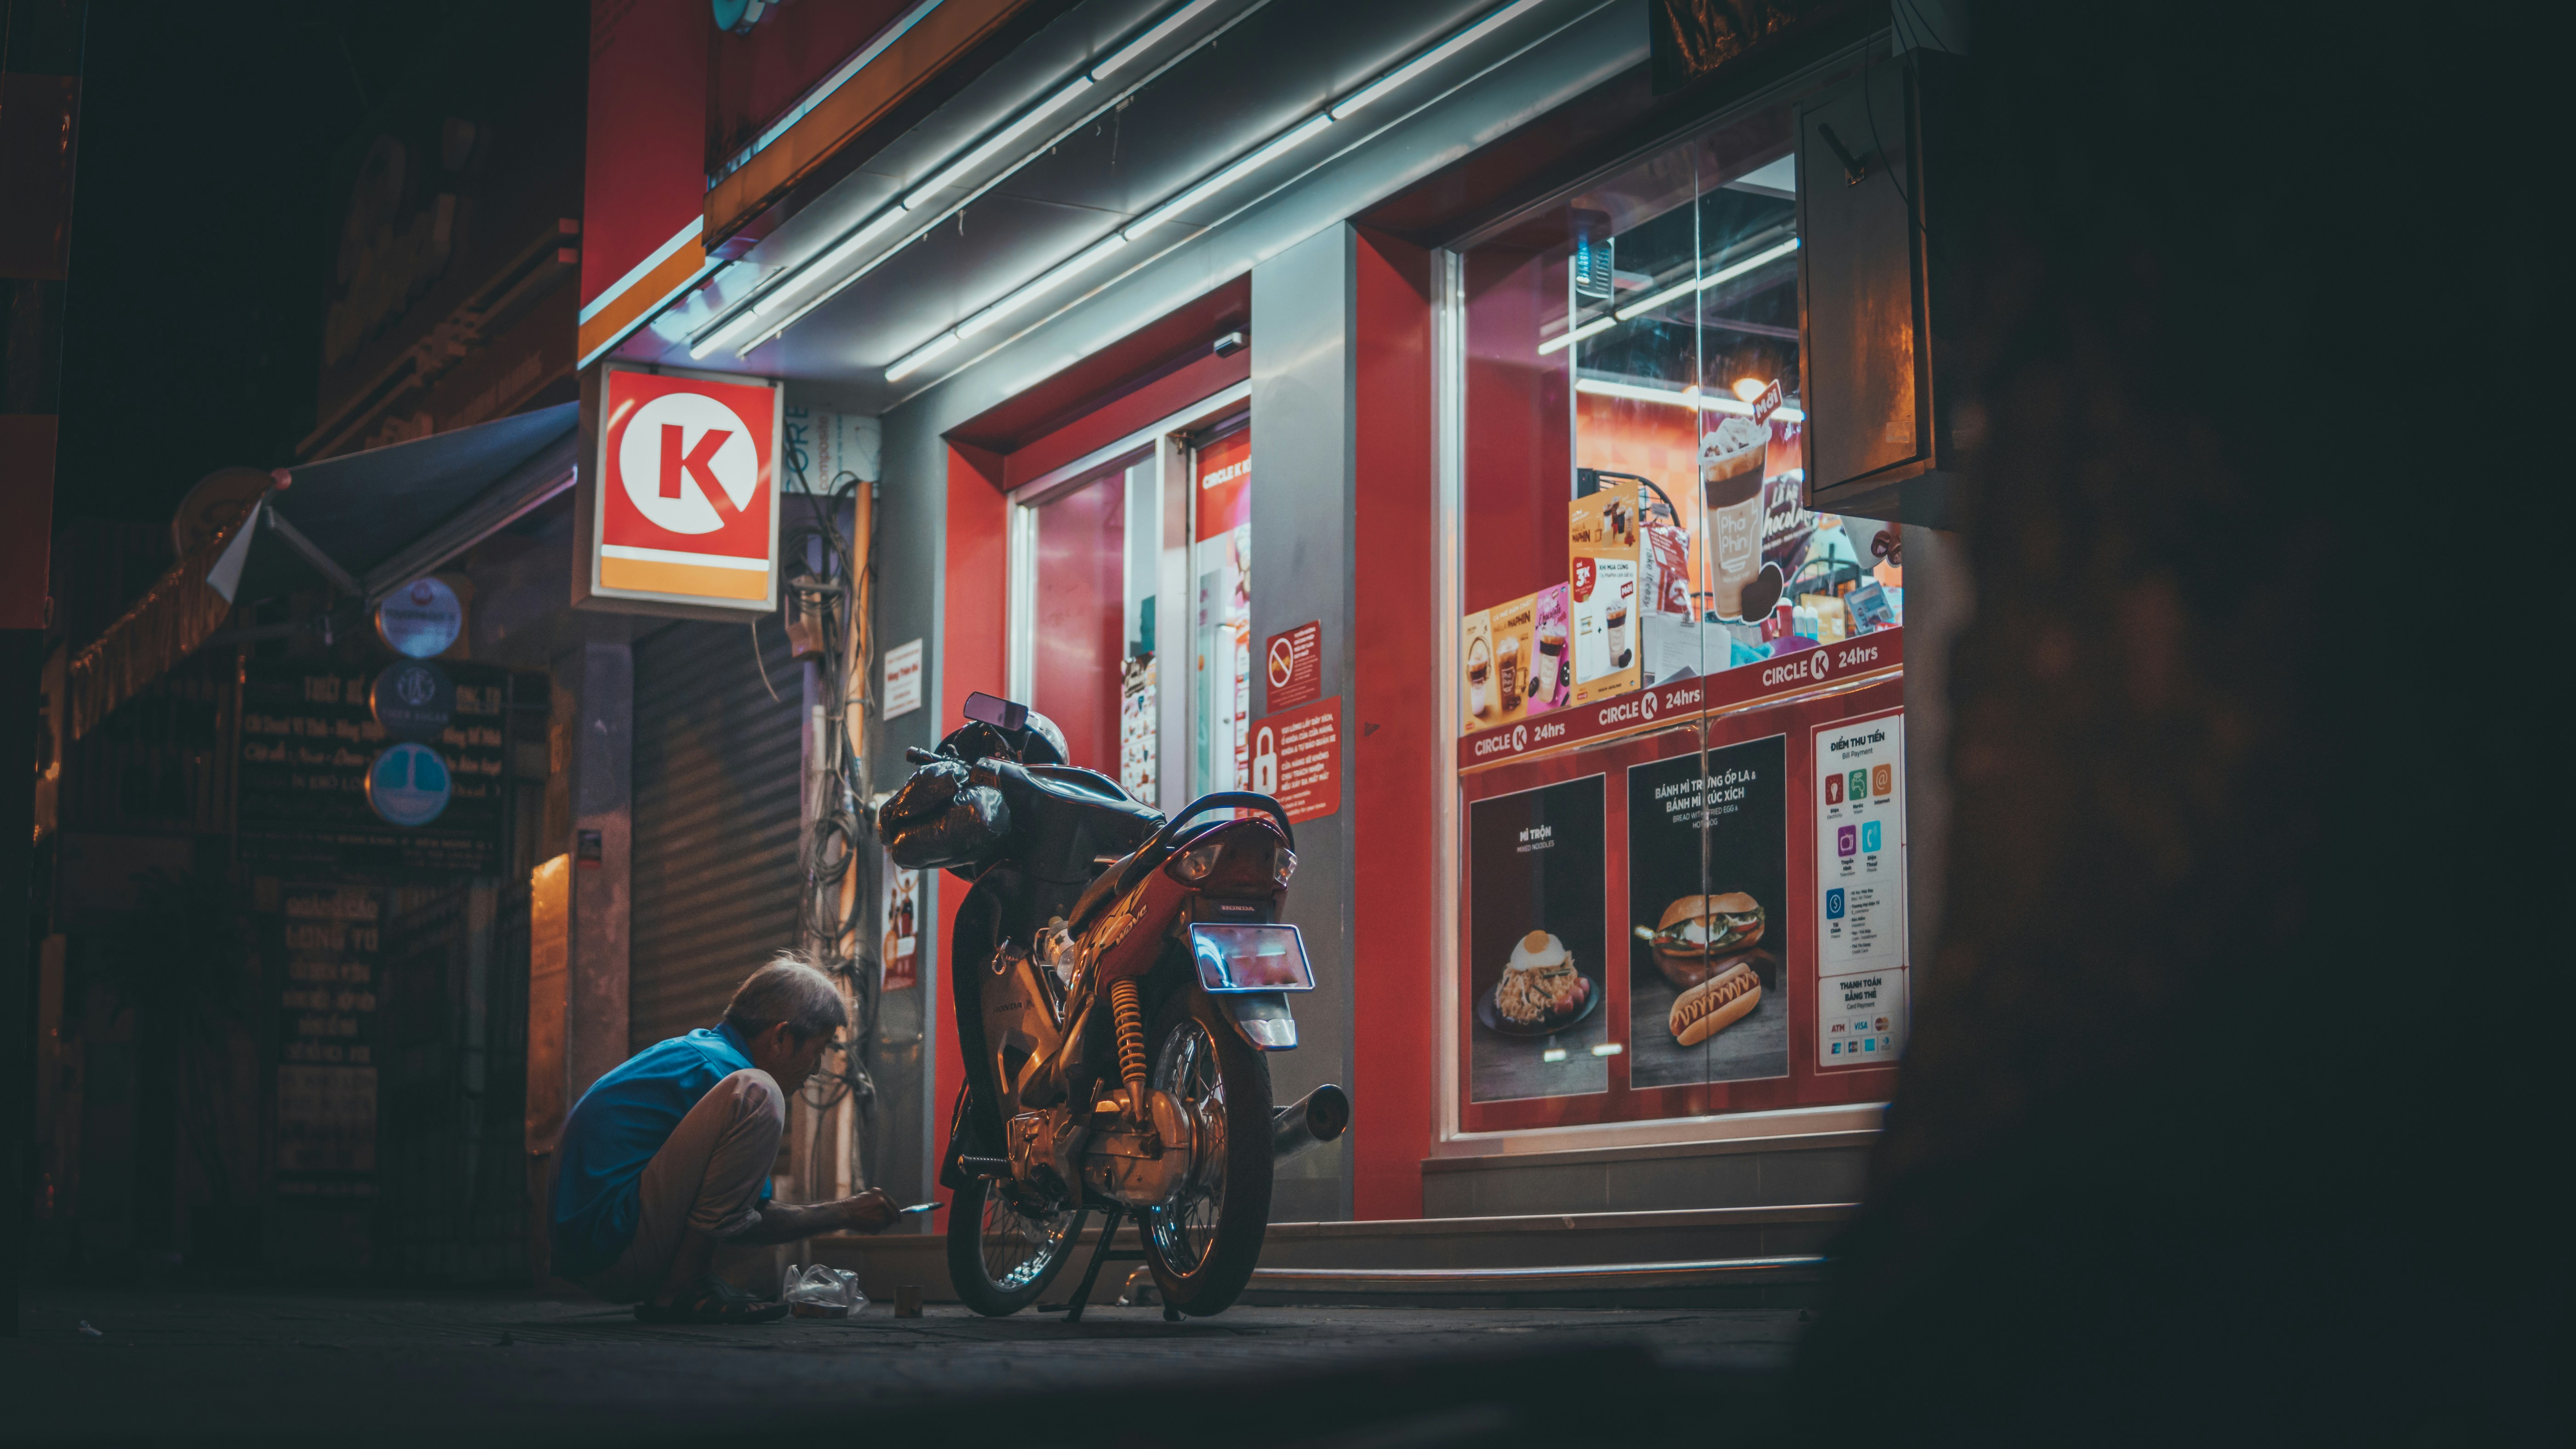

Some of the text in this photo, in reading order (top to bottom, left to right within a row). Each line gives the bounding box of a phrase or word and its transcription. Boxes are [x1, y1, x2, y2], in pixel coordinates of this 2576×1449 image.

[1202, 465, 1234, 490] CIRCLE
[1234, 462, 1242, 477] K
[1721, 515, 1746, 534] Pha
[1762, 500, 1814, 538] hocolate
[1722, 534, 1747, 553] Phin
[1576, 566, 1591, 587] 3K
[1646, 572, 1654, 582] it
[1643, 583, 1652, 607] easy
[1507, 610, 1531, 628] PHAPHIN
[1763, 660, 1807, 686] CIRCLE
[1839, 646, 1878, 668] 24hrs
[1599, 700, 1638, 725] CIRCLE
[1666, 689, 1700, 709] 24hrs
[1475, 733, 1511, 756] CIRCLE
[1534, 722, 1565, 741] 24hrs
[1830, 728, 1885, 751] ĐIỂM THU TIỀN
[1312, 751, 1329, 762] KHÔNG
[1851, 747, 1873, 758] Payment
[1655, 783, 1678, 800] BÁNH
[1680, 779, 1690, 794] MÌ
[1724, 768, 1737, 785] ỐP
[1738, 770, 1750, 782] LA
[1751, 771, 1756, 780] &
[1666, 797, 1690, 813] BÁNH
[1691, 793, 1701, 808] MÌ
[1724, 786, 1745, 801] XÍCH
[1672, 813, 1690, 823] BREAD
[1723, 804, 1734, 813] EGG
[1519, 825, 1551, 842] MÌ TRỘN
[1517, 840, 1555, 853] MIXED NOODLES
[1840, 975, 1882, 990] THANH TOÁN
[1845, 987, 1877, 1002] BẰNG THẺ
[993, 1002, 1024, 1014] HONDA
[1831, 1021, 1868, 1033] ATM VISA
